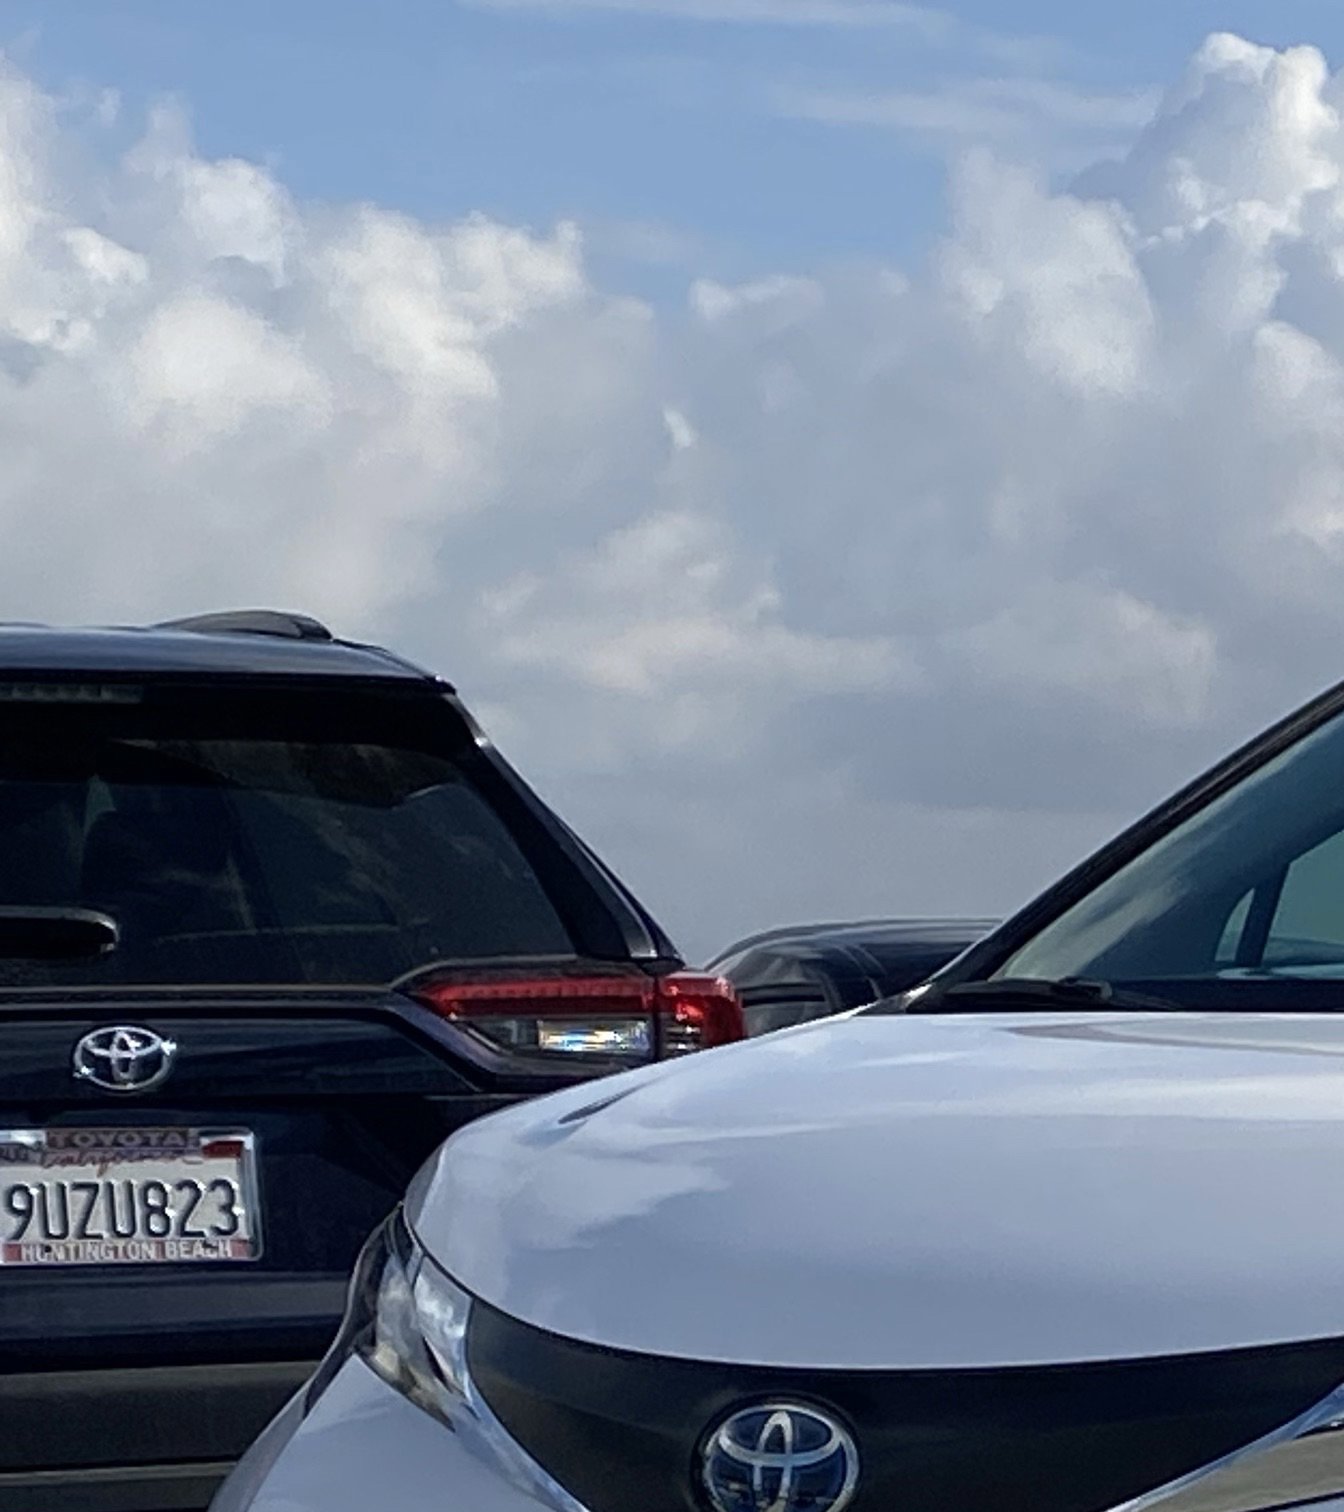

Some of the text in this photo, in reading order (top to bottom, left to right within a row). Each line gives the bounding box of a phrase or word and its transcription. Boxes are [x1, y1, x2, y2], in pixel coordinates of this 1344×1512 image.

[52, 1129, 186, 1147] TOYOTA
[3, 1179, 239, 1240] 9UZU823
[20, 1239, 233, 1261] HUNTINGTON BEACH
